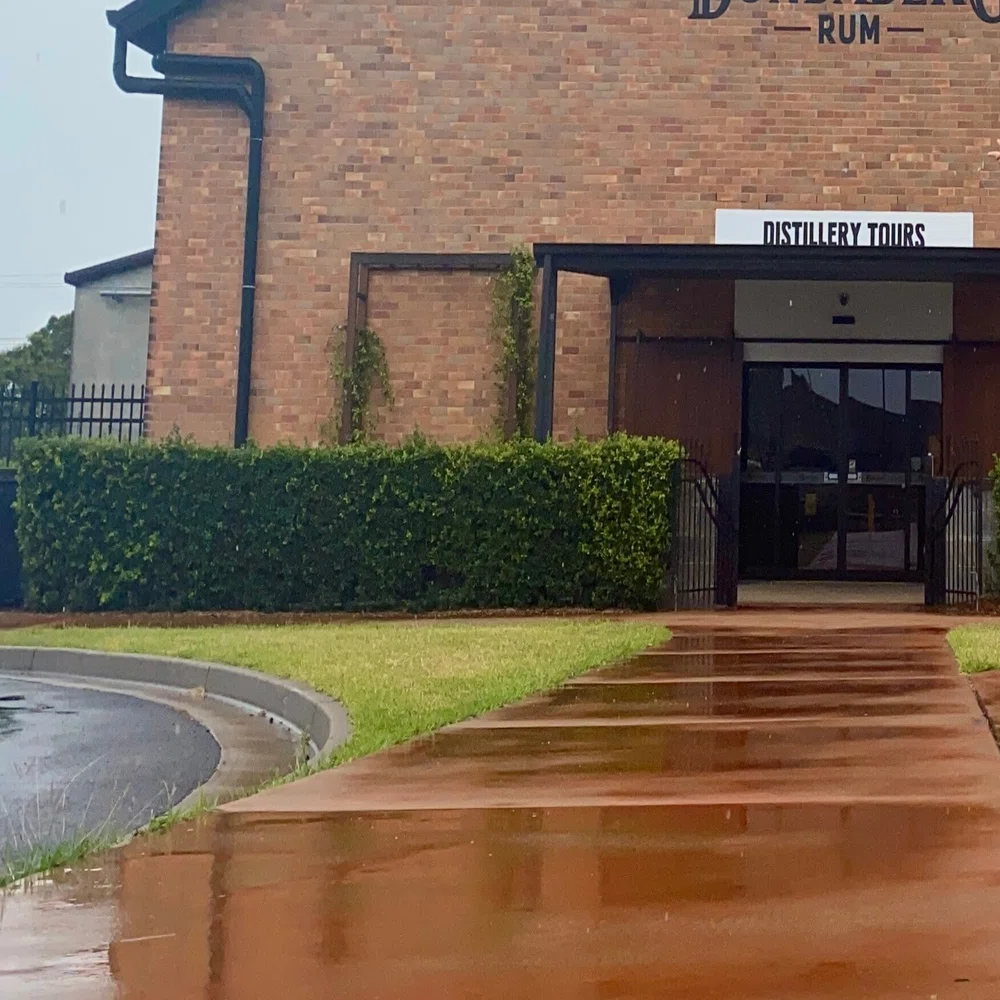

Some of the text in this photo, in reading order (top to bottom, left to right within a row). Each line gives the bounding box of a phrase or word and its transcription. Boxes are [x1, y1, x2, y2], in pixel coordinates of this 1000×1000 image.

[818, 14, 880, 45] RUM
[763, 221, 926, 246] DISTILLERY TOURS
